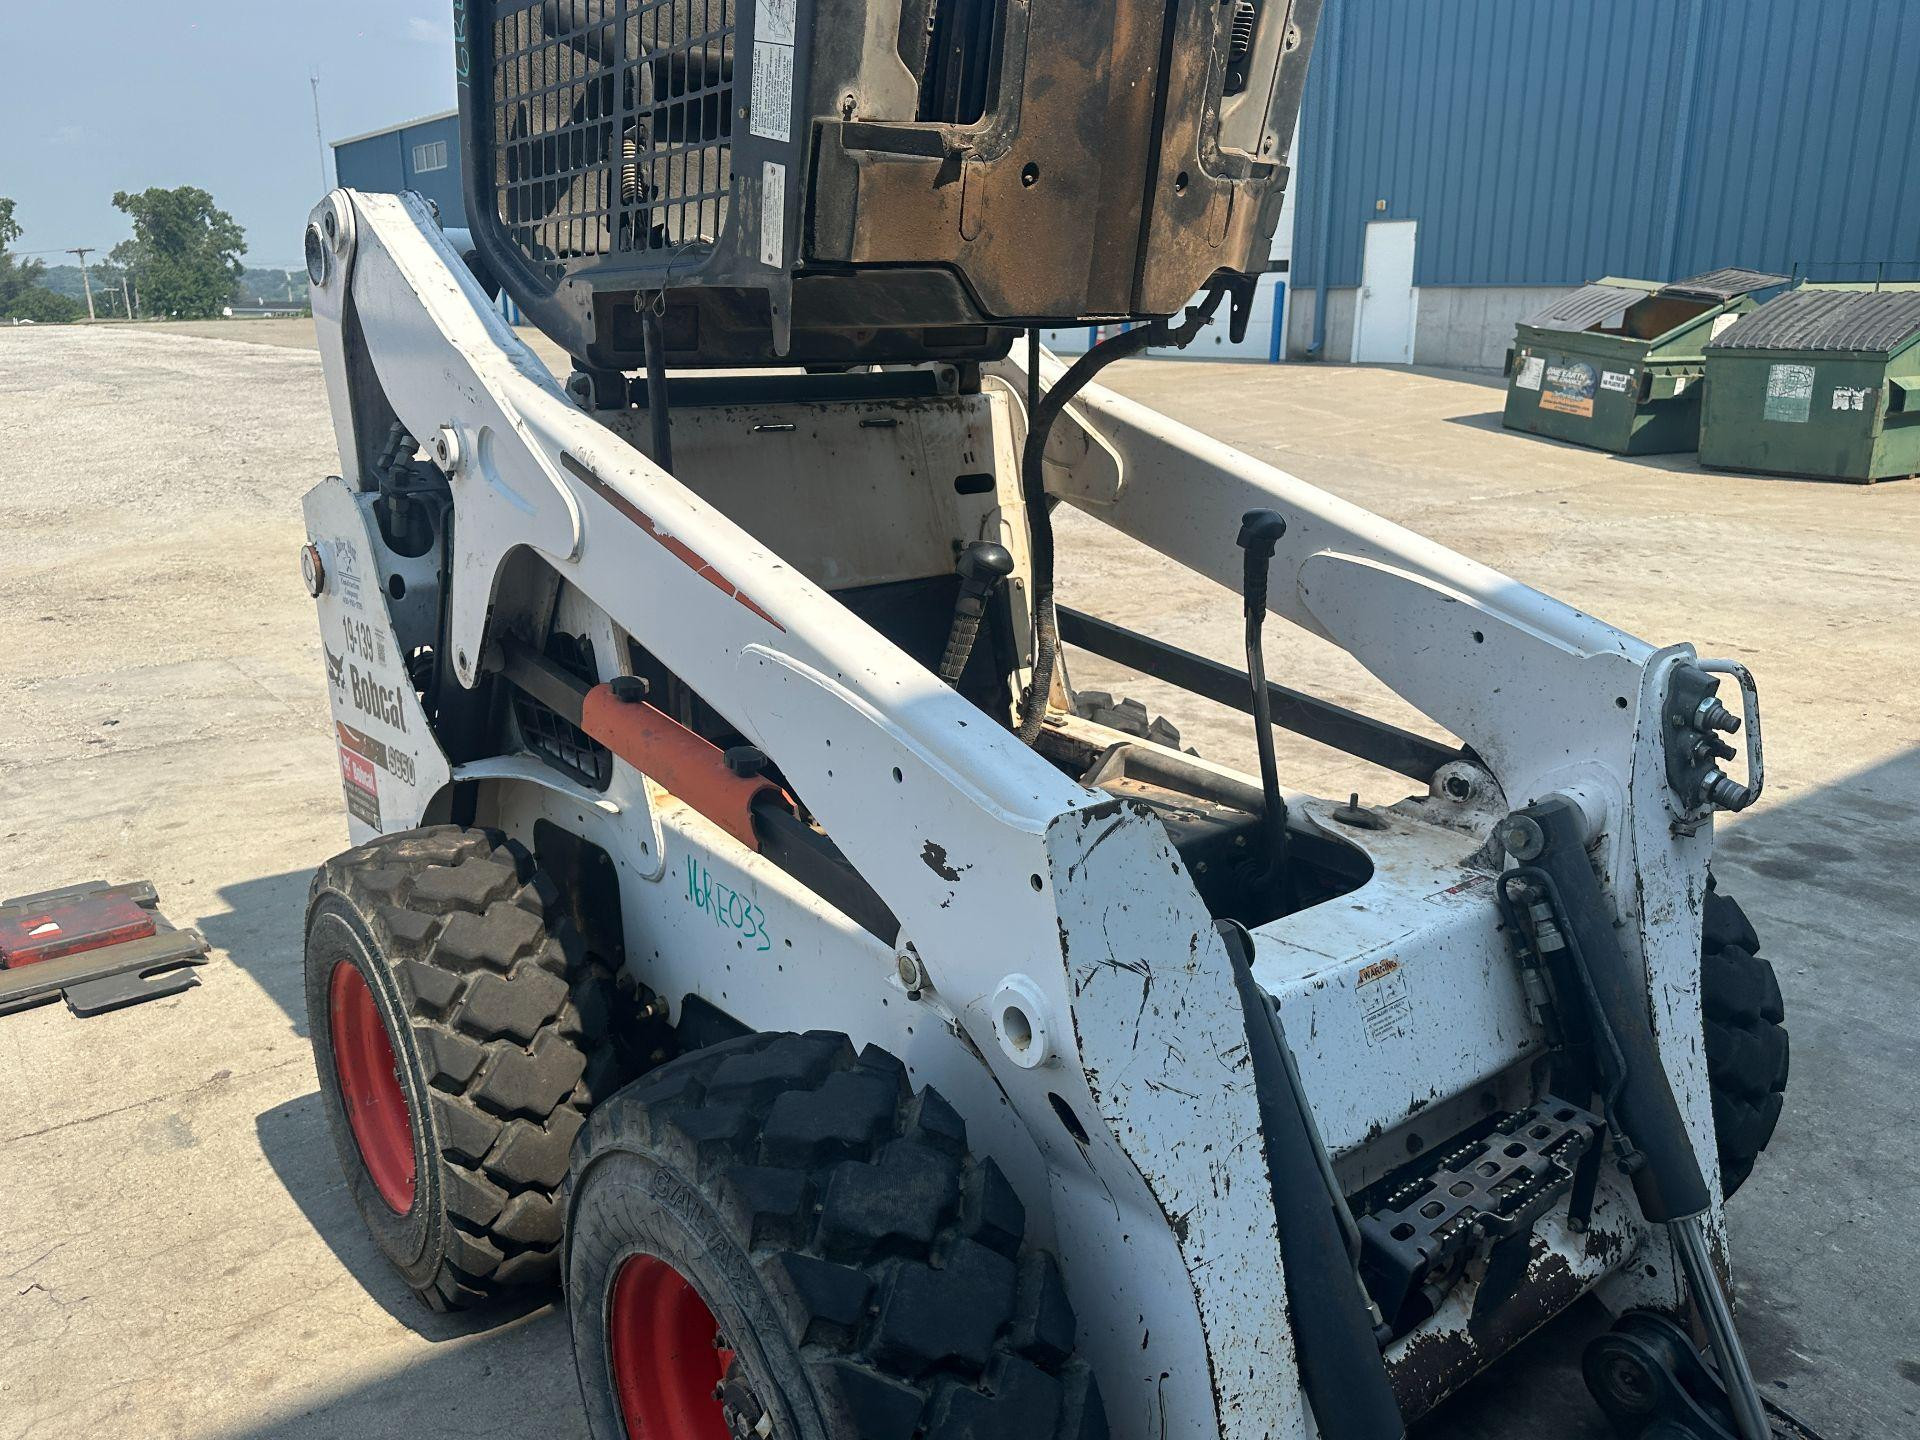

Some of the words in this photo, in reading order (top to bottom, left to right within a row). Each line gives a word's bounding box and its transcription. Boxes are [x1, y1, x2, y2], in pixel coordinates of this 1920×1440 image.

[343, 615, 374, 663] 19-139
[350, 663, 407, 734] Bobcat
[387, 745, 416, 787] S650
[687, 854, 771, 951] 16RE033
[1364, 960, 1398, 980] WARNING
